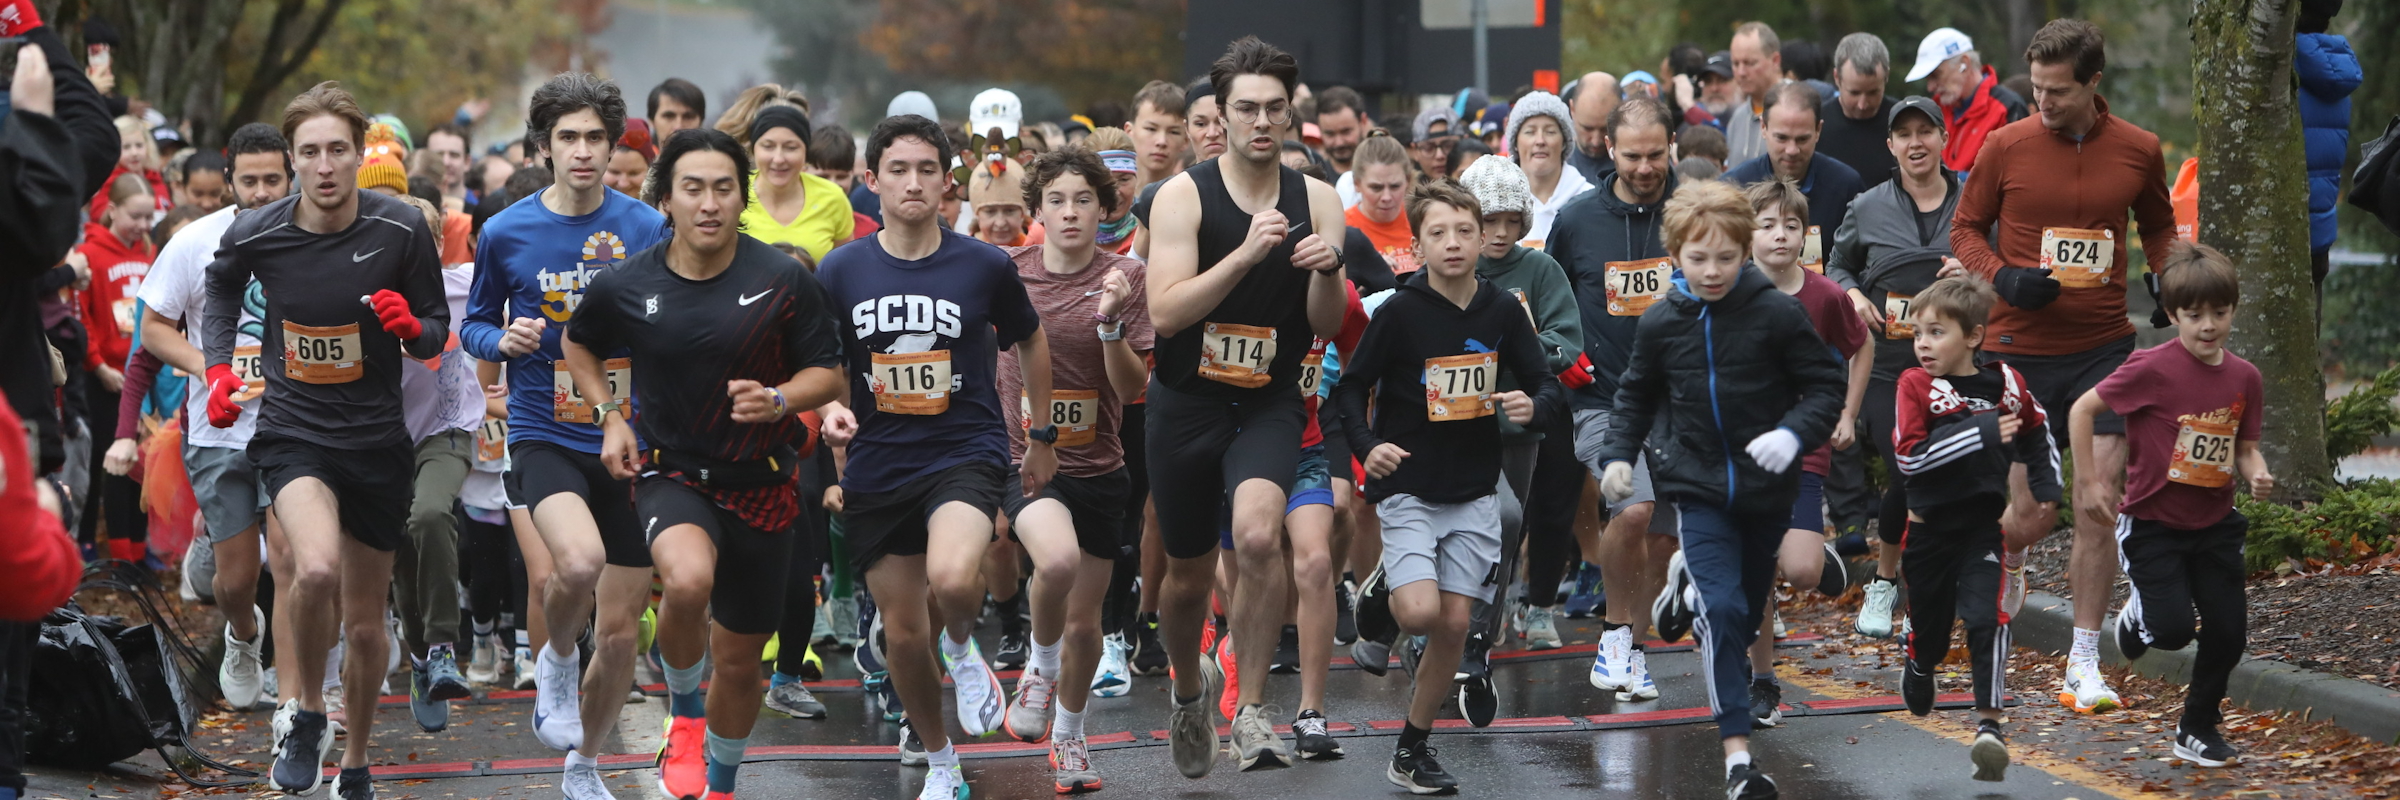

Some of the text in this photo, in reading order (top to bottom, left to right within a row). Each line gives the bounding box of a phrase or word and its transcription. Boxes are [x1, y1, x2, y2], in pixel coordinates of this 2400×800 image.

[2057, 240, 2099, 264] 624
[536, 262, 602, 292] turk
[1620, 269, 1659, 295] 786
[852, 295, 962, 340] SCDS
[298, 336, 344, 361] 605
[1221, 336, 1263, 366] 114
[888, 364, 935, 390] 116
[1445, 366, 1485, 394] 770
[1052, 402, 1082, 424] 86
[2192, 435, 2230, 463] 625
